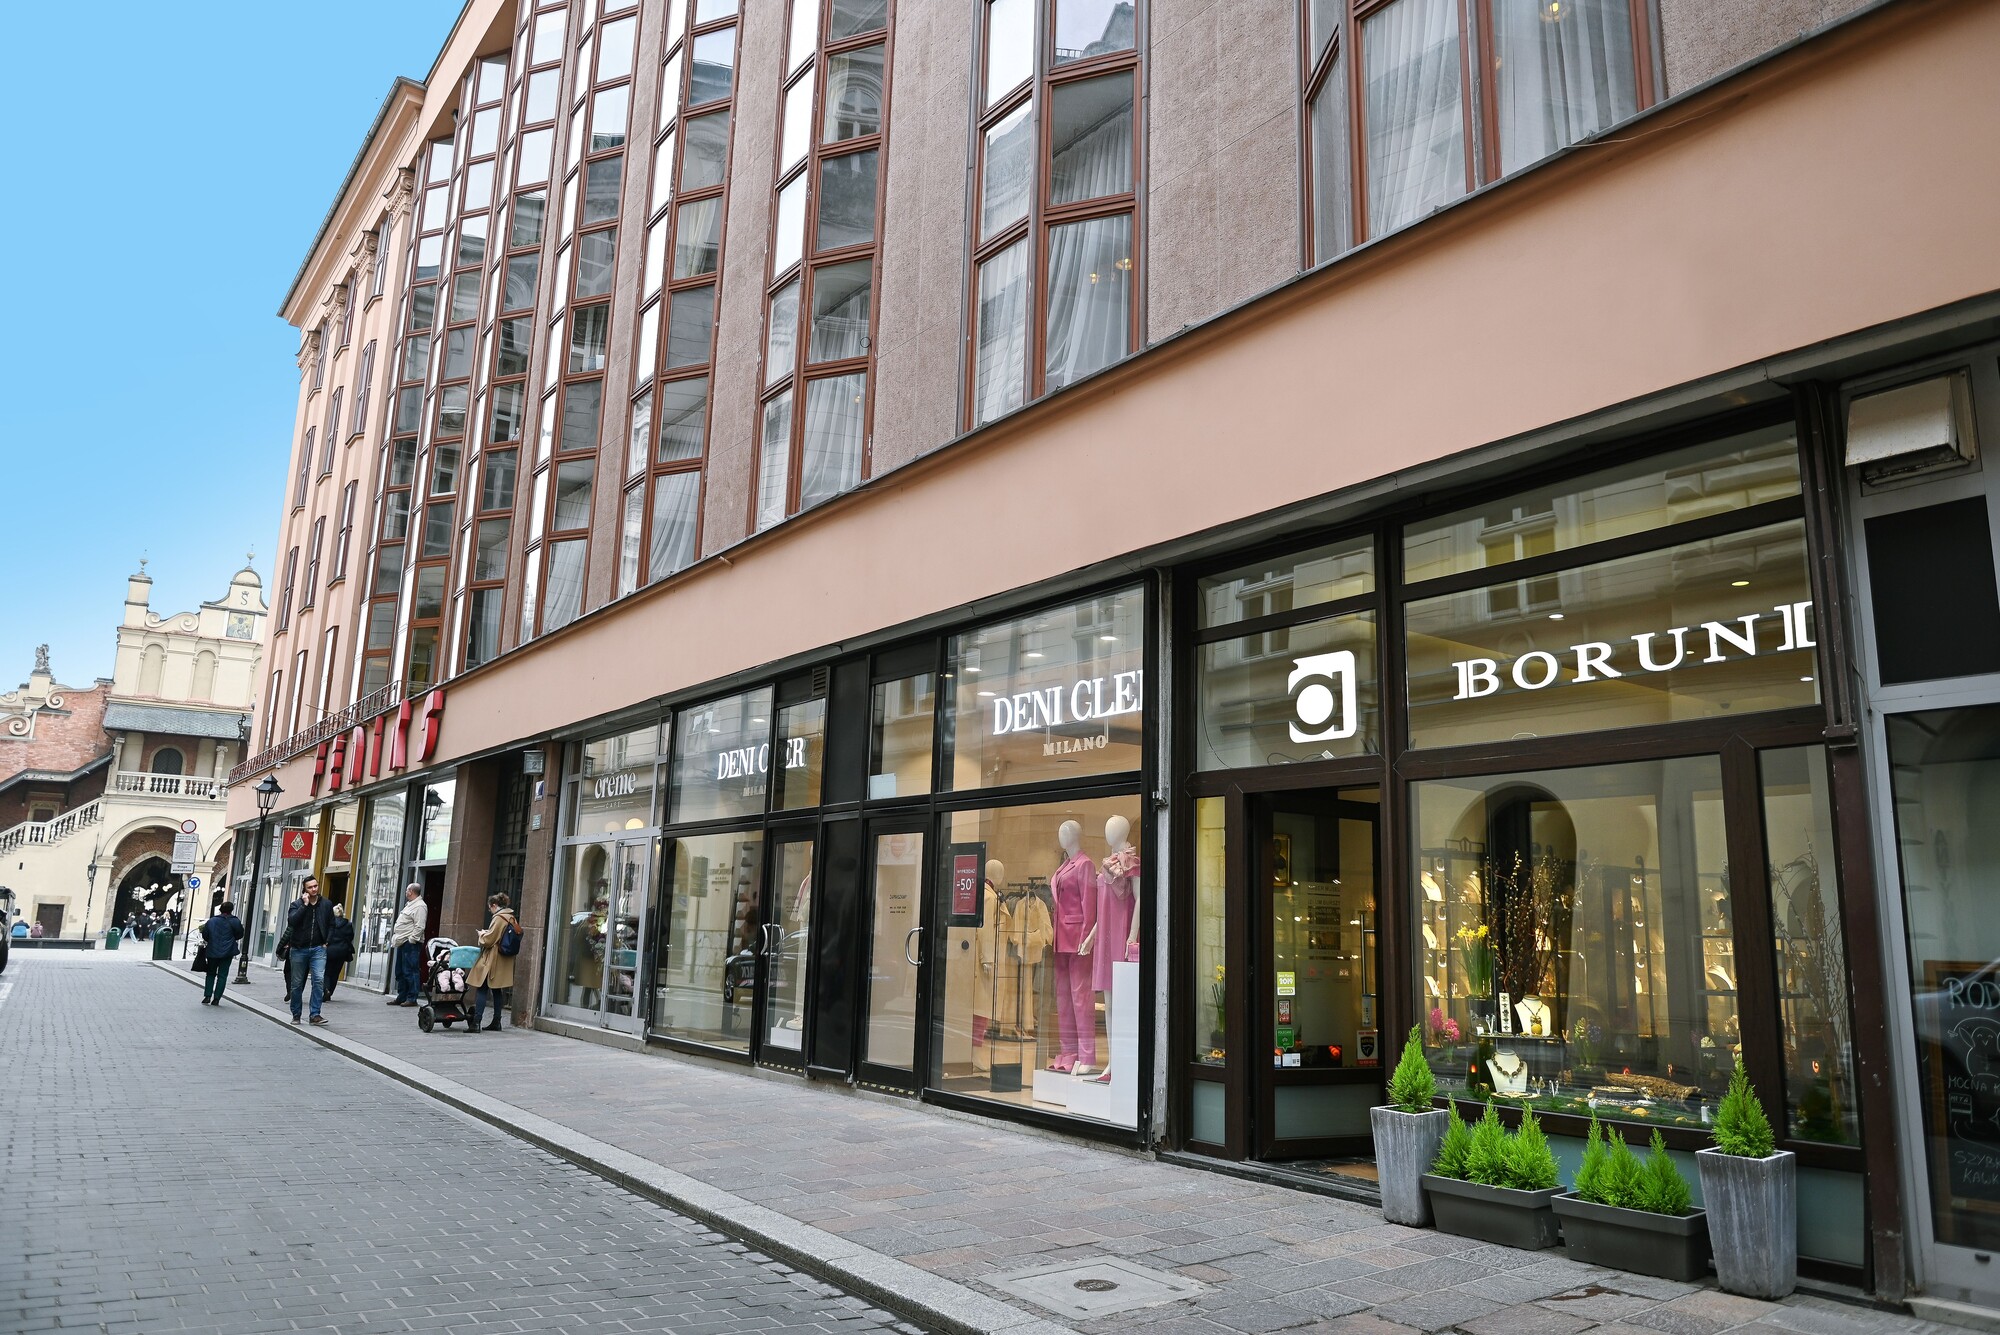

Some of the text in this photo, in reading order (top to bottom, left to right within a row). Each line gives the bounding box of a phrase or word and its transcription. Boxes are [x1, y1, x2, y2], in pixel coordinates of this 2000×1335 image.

[993, 686, 1064, 736] DENI
[1043, 734, 1107, 757] MILANO
[717, 746, 756, 780] DENI
[1948, 1075, 1988, 1092] MOCNA
